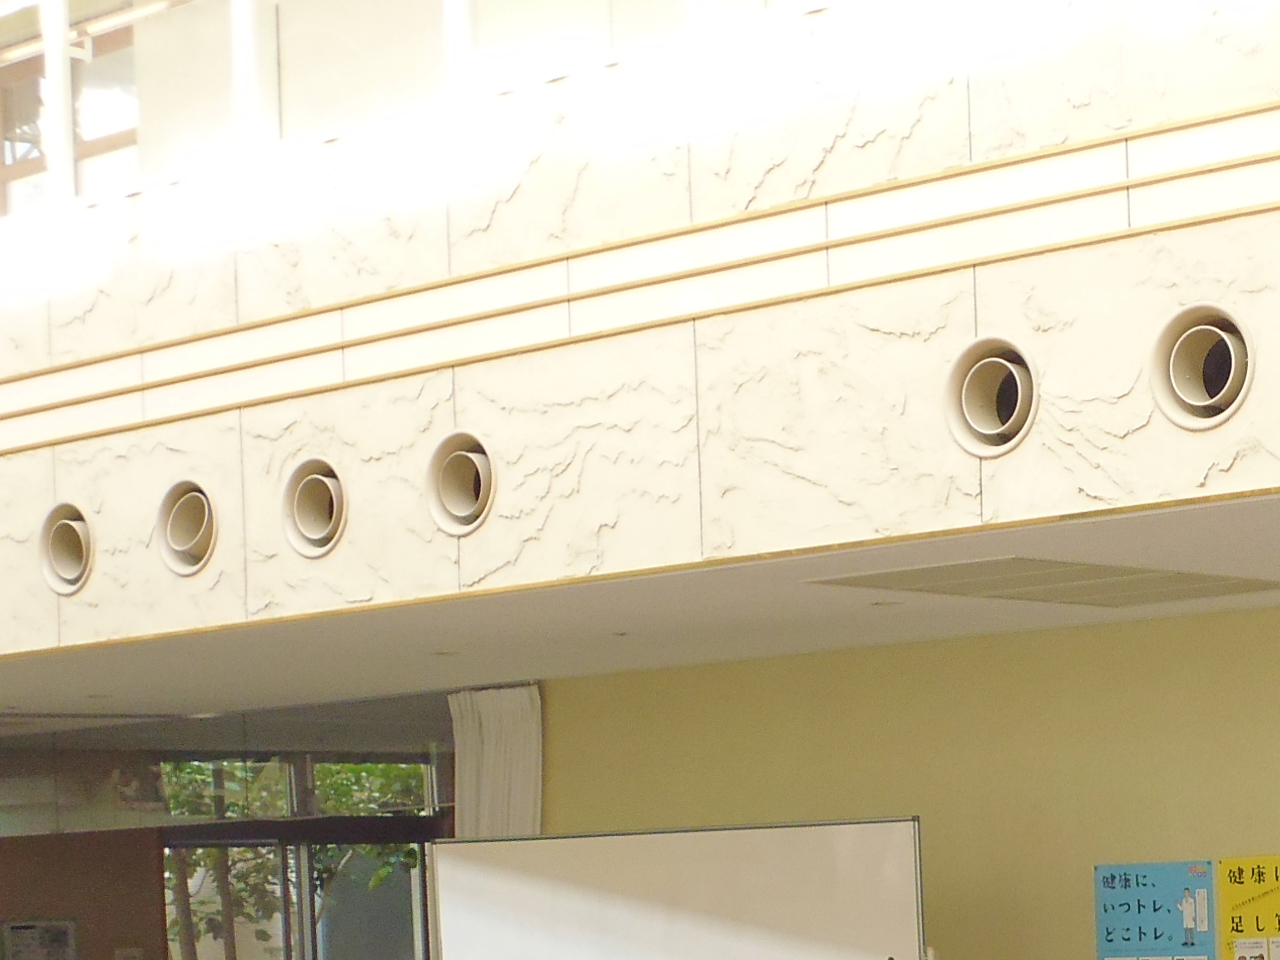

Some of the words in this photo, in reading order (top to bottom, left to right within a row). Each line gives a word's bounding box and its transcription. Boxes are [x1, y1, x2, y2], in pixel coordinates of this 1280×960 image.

[1102, 872, 1156, 890] 健康に、
[1103, 898, 1171, 914] いつトレ、
[1105, 926, 1173, 943] どこトレ。
